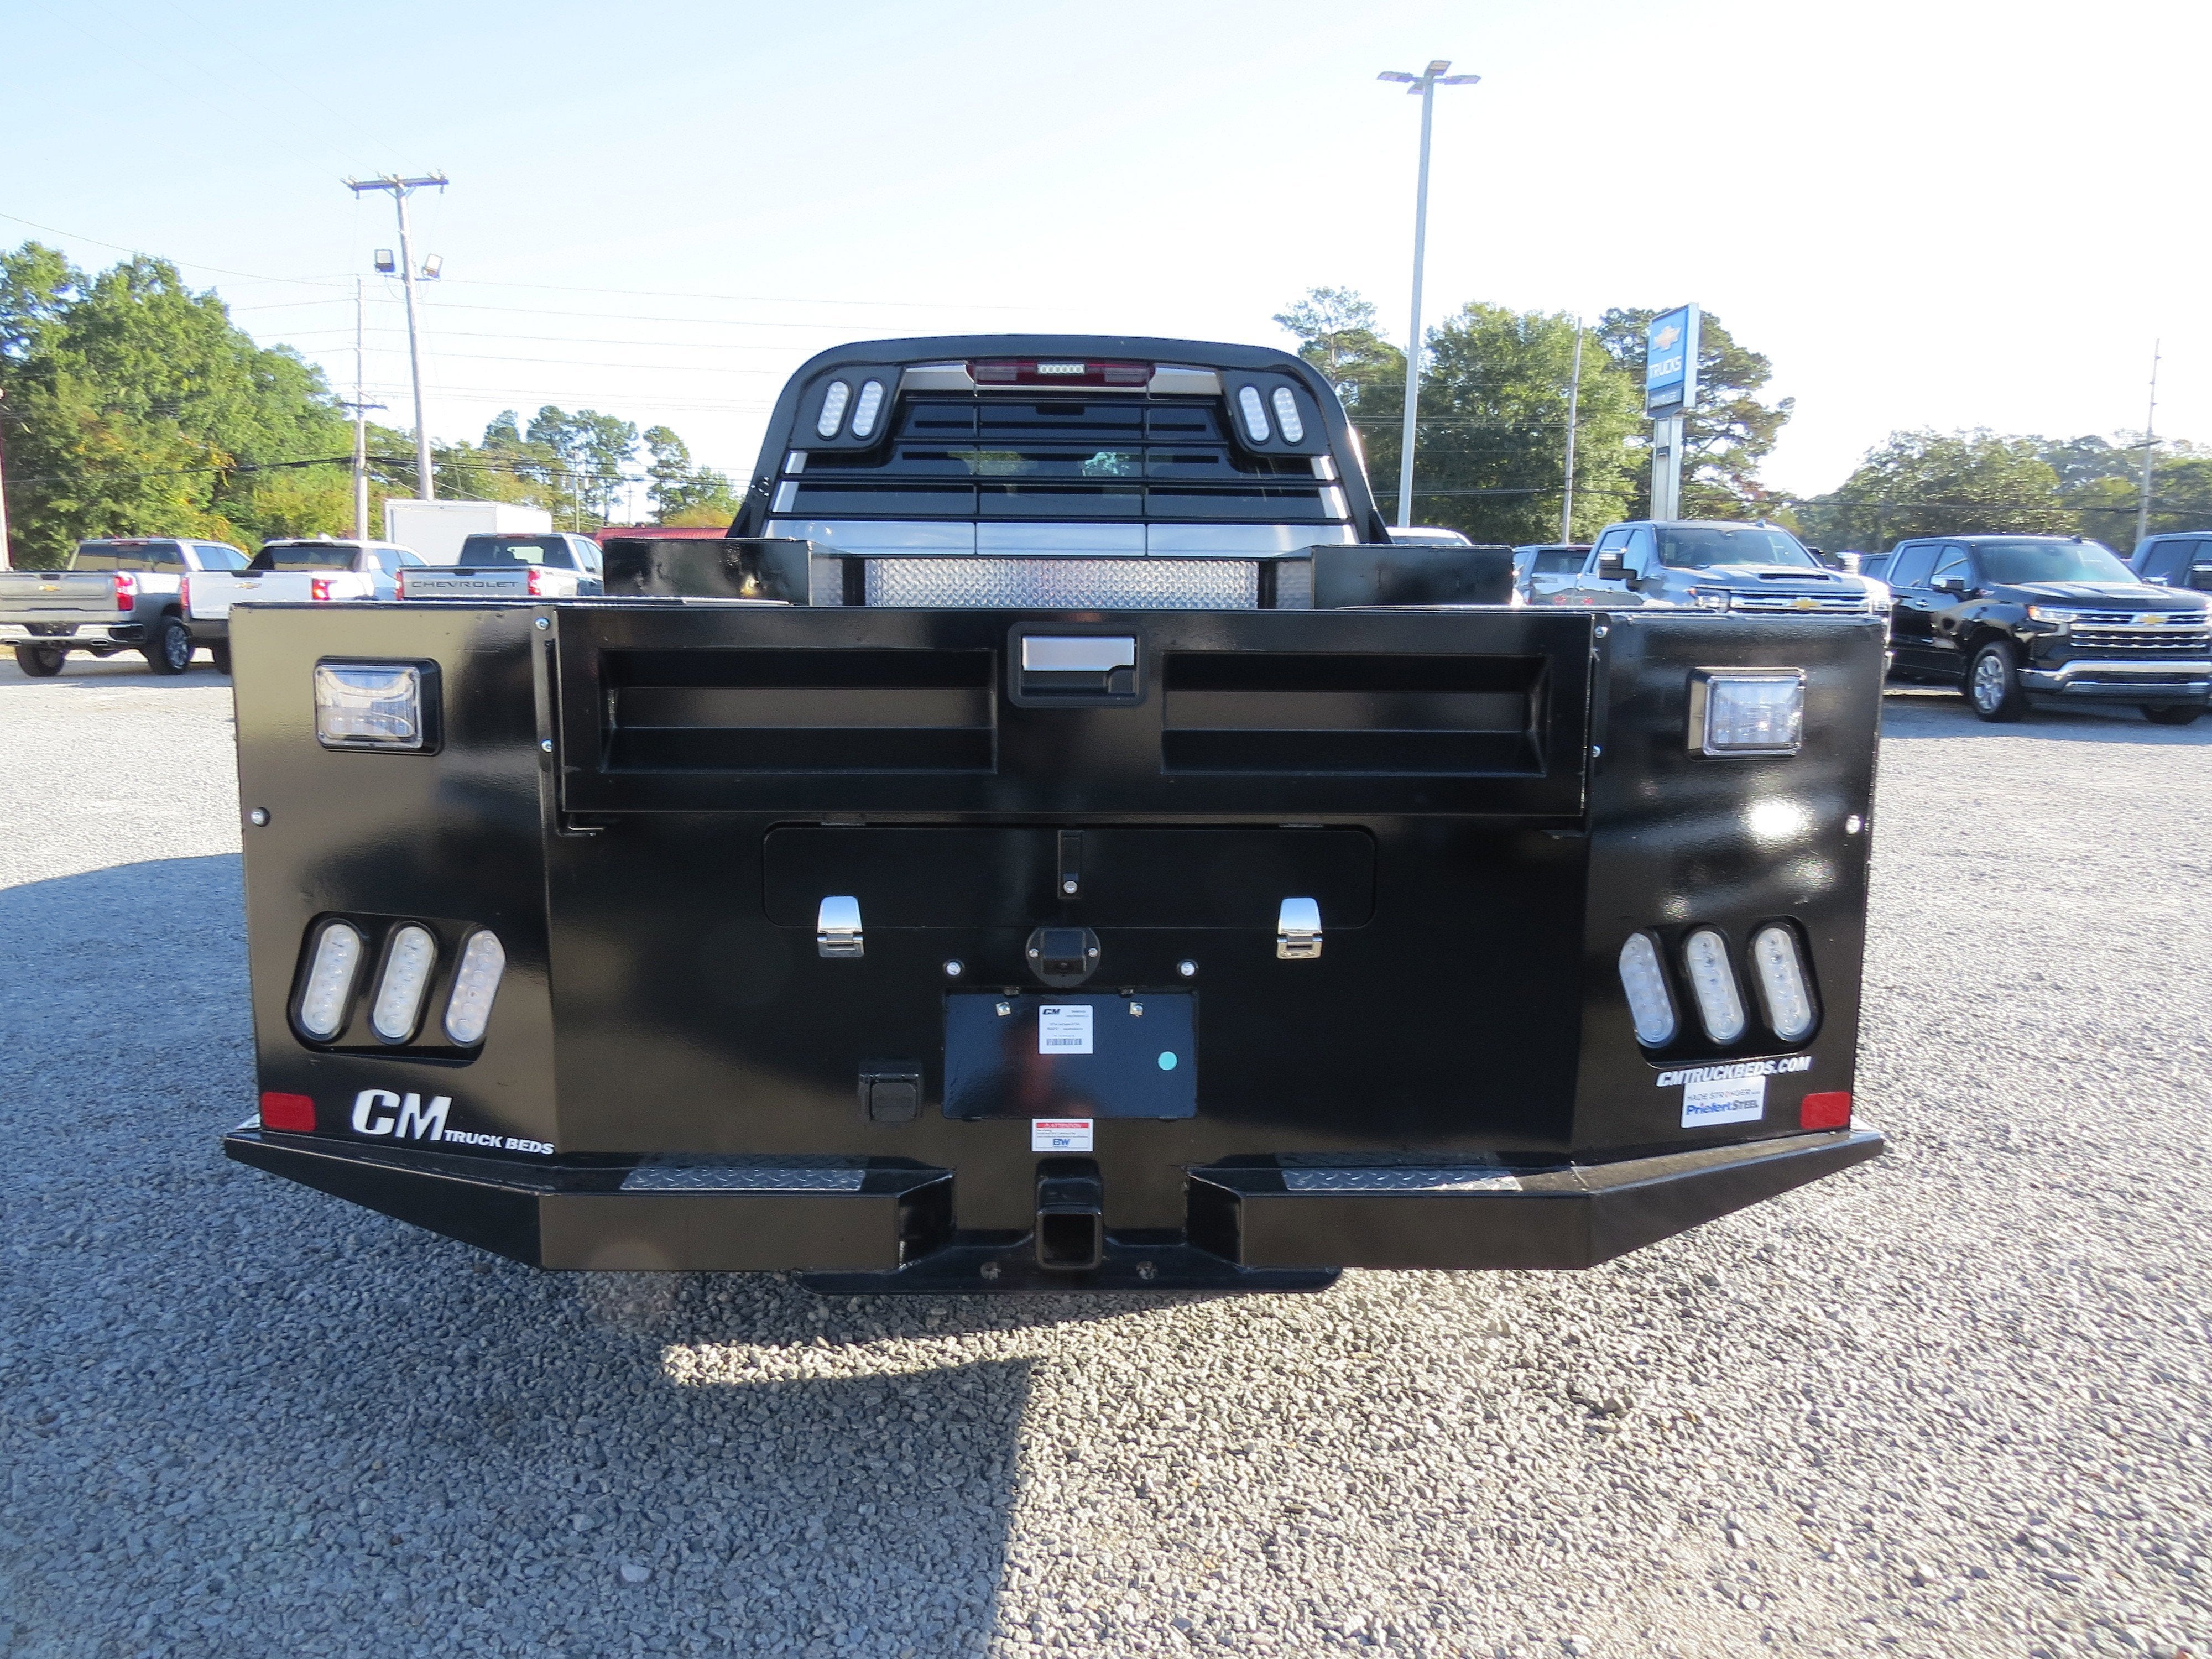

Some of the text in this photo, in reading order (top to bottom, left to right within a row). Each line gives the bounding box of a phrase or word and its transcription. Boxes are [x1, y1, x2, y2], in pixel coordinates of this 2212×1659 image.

[1648, 355, 1682, 379] TRUCKS
[1656, 1056, 1812, 1087] CMTRUCKBEDS.COM
[352, 1089, 555, 1155] CM TRUCK BEDS
